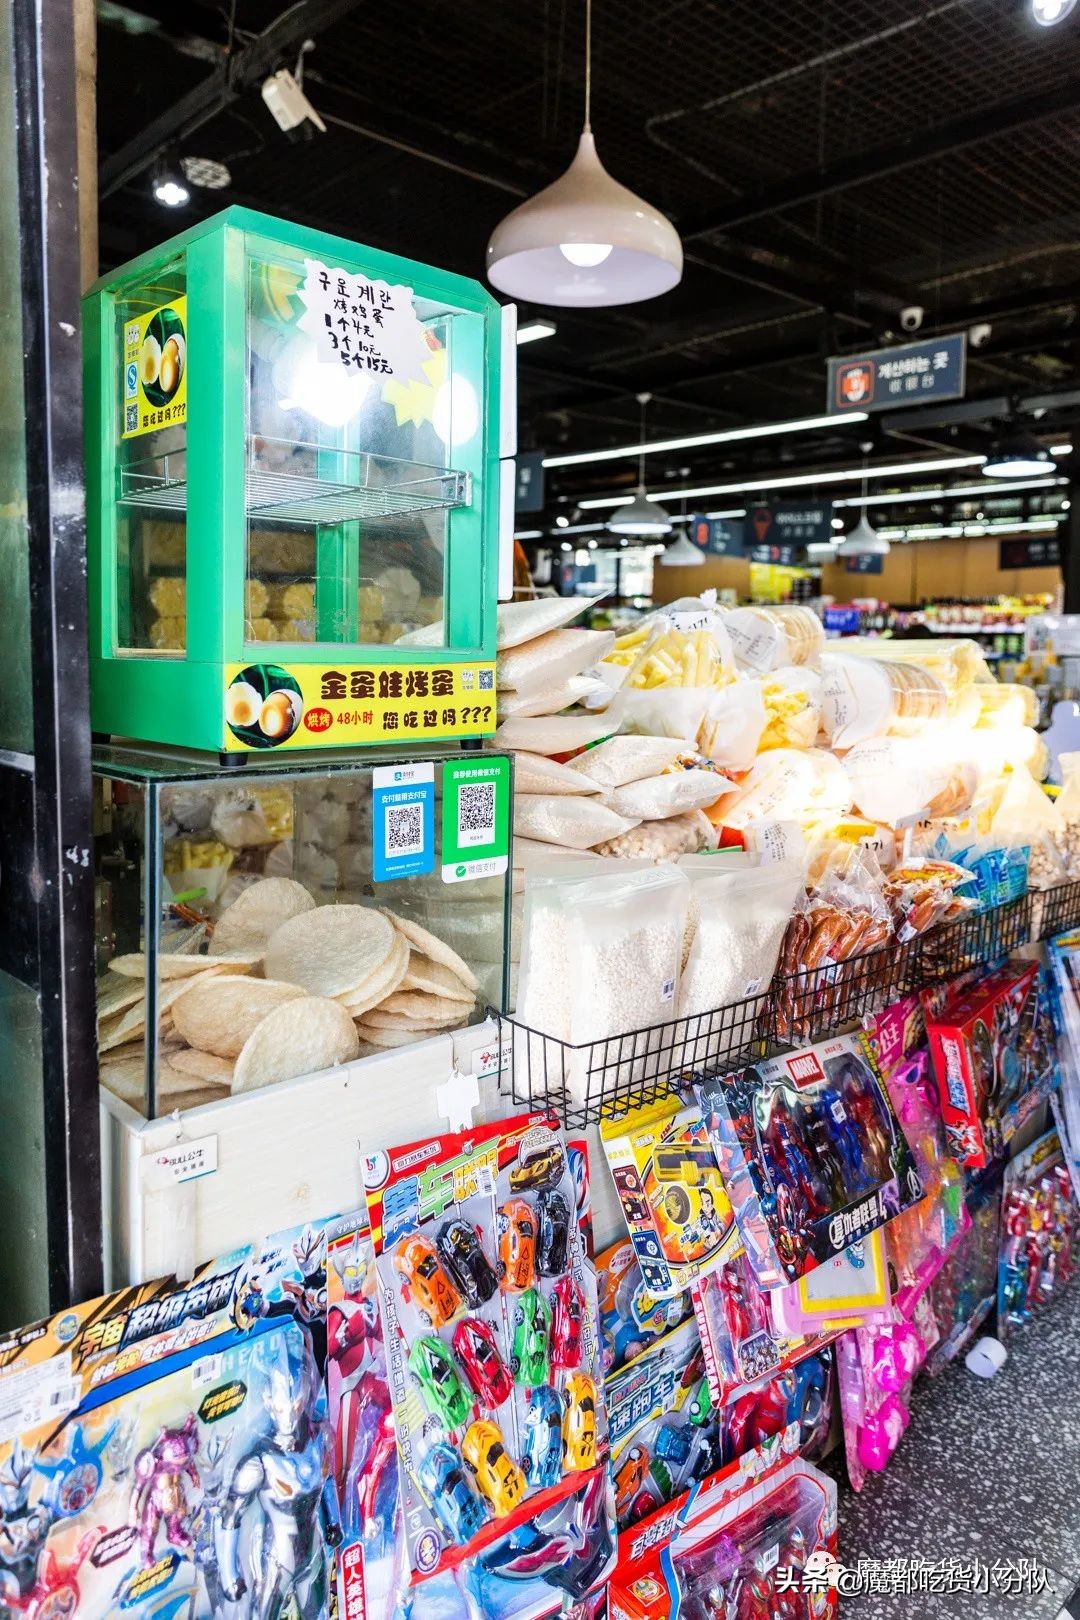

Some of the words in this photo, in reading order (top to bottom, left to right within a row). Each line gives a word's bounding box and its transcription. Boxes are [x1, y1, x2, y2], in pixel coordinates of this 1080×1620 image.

[333, 298, 385, 328] 烤鸡蛋
[320, 669, 454, 700] 金蛋娃烤蛋
[307, 712, 331, 728] 烘烤
[336, 710, 374, 726] 48小时
[383, 705, 492, 731] 您吃过吗???
[468, 862, 497, 875] 微信支付
[829, 1191, 887, 1249] 复仇者联盟4
